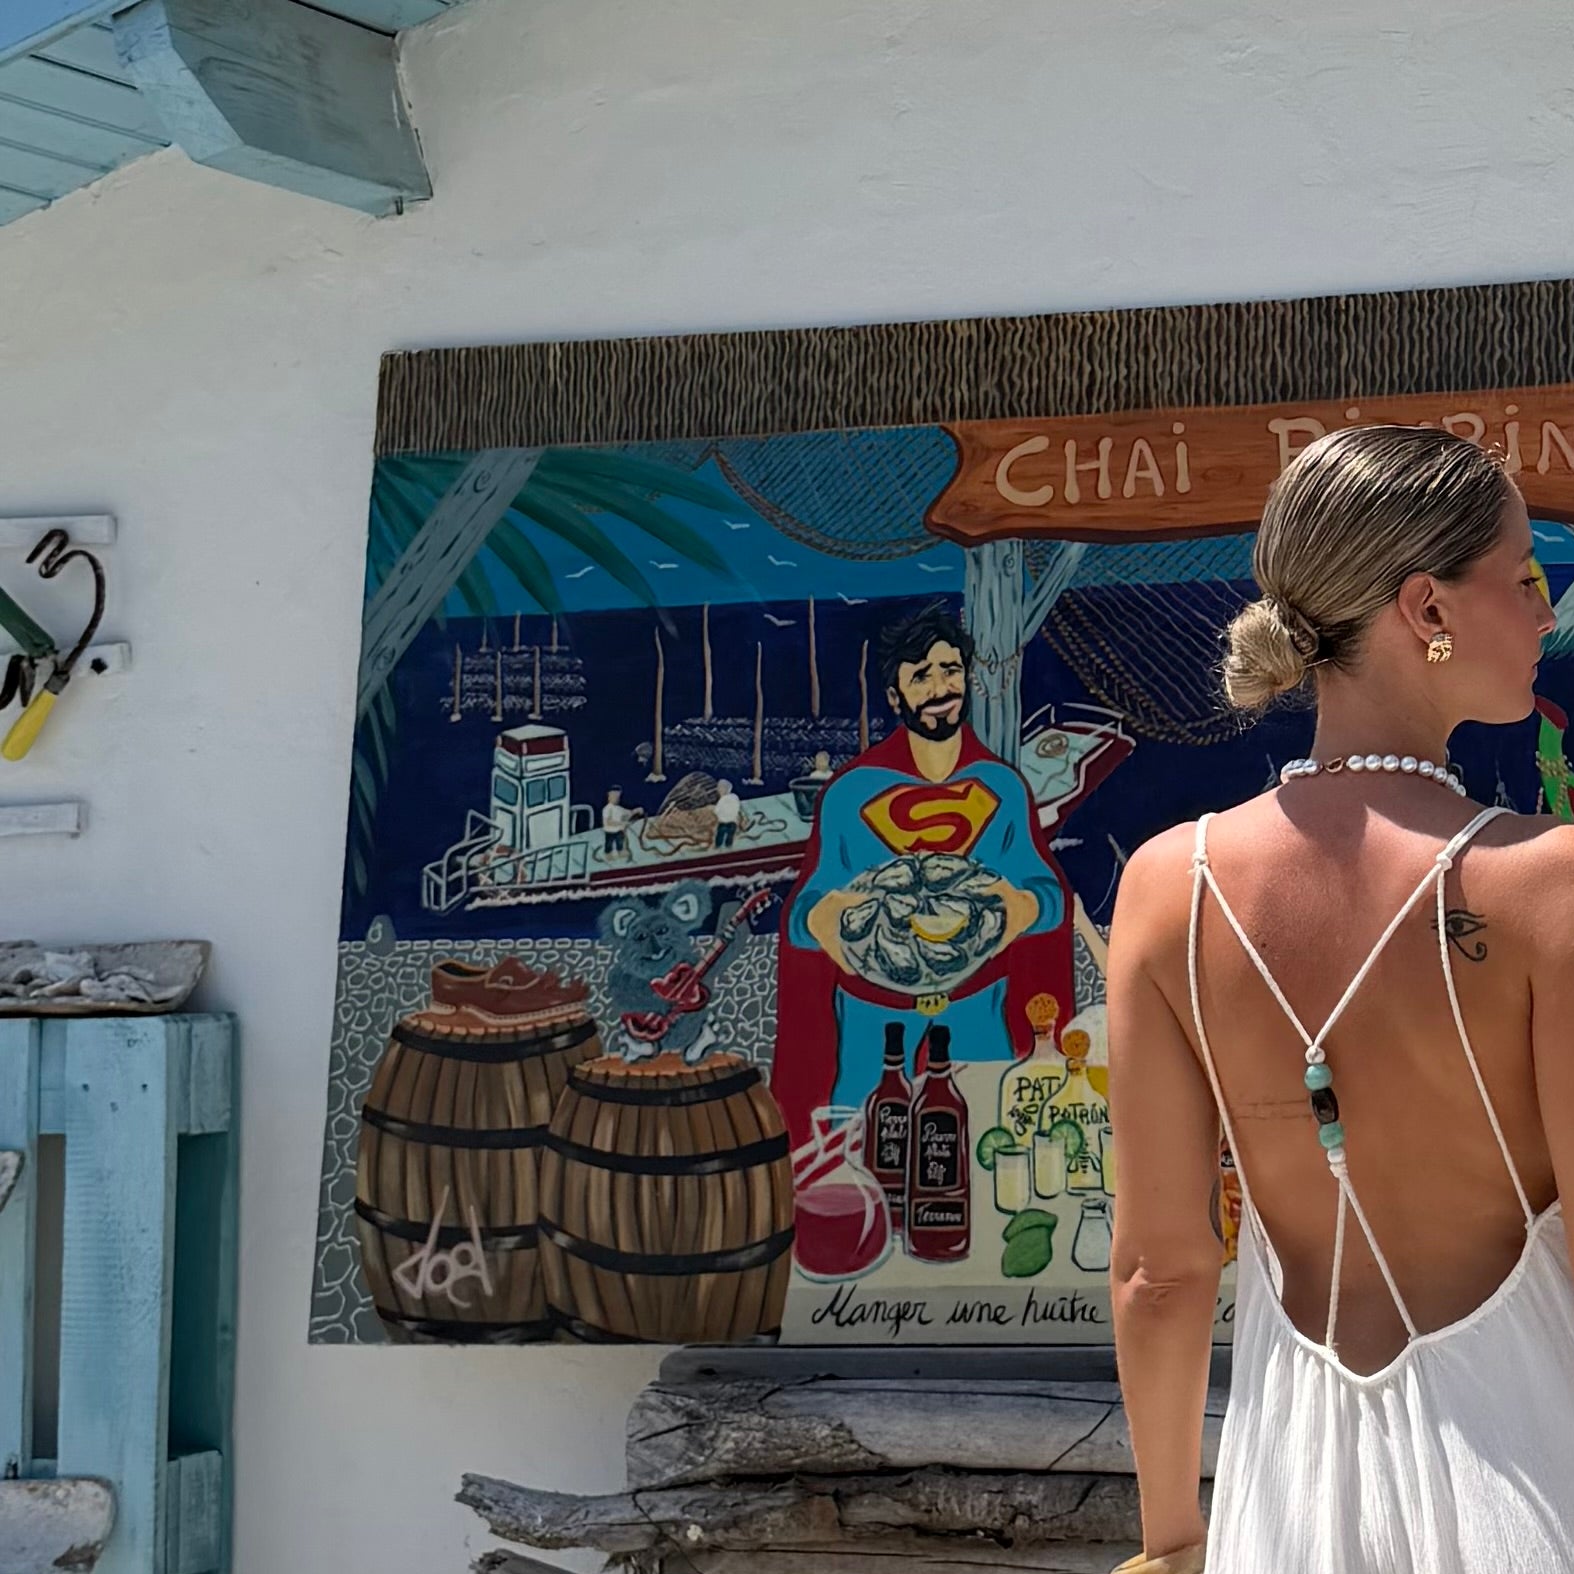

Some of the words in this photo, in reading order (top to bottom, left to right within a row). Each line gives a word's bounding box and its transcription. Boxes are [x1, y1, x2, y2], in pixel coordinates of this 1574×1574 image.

[1012, 1076, 1062, 1102] PAT
[811, 1284, 935, 1339] Manger
[945, 1299, 1015, 1326] une
